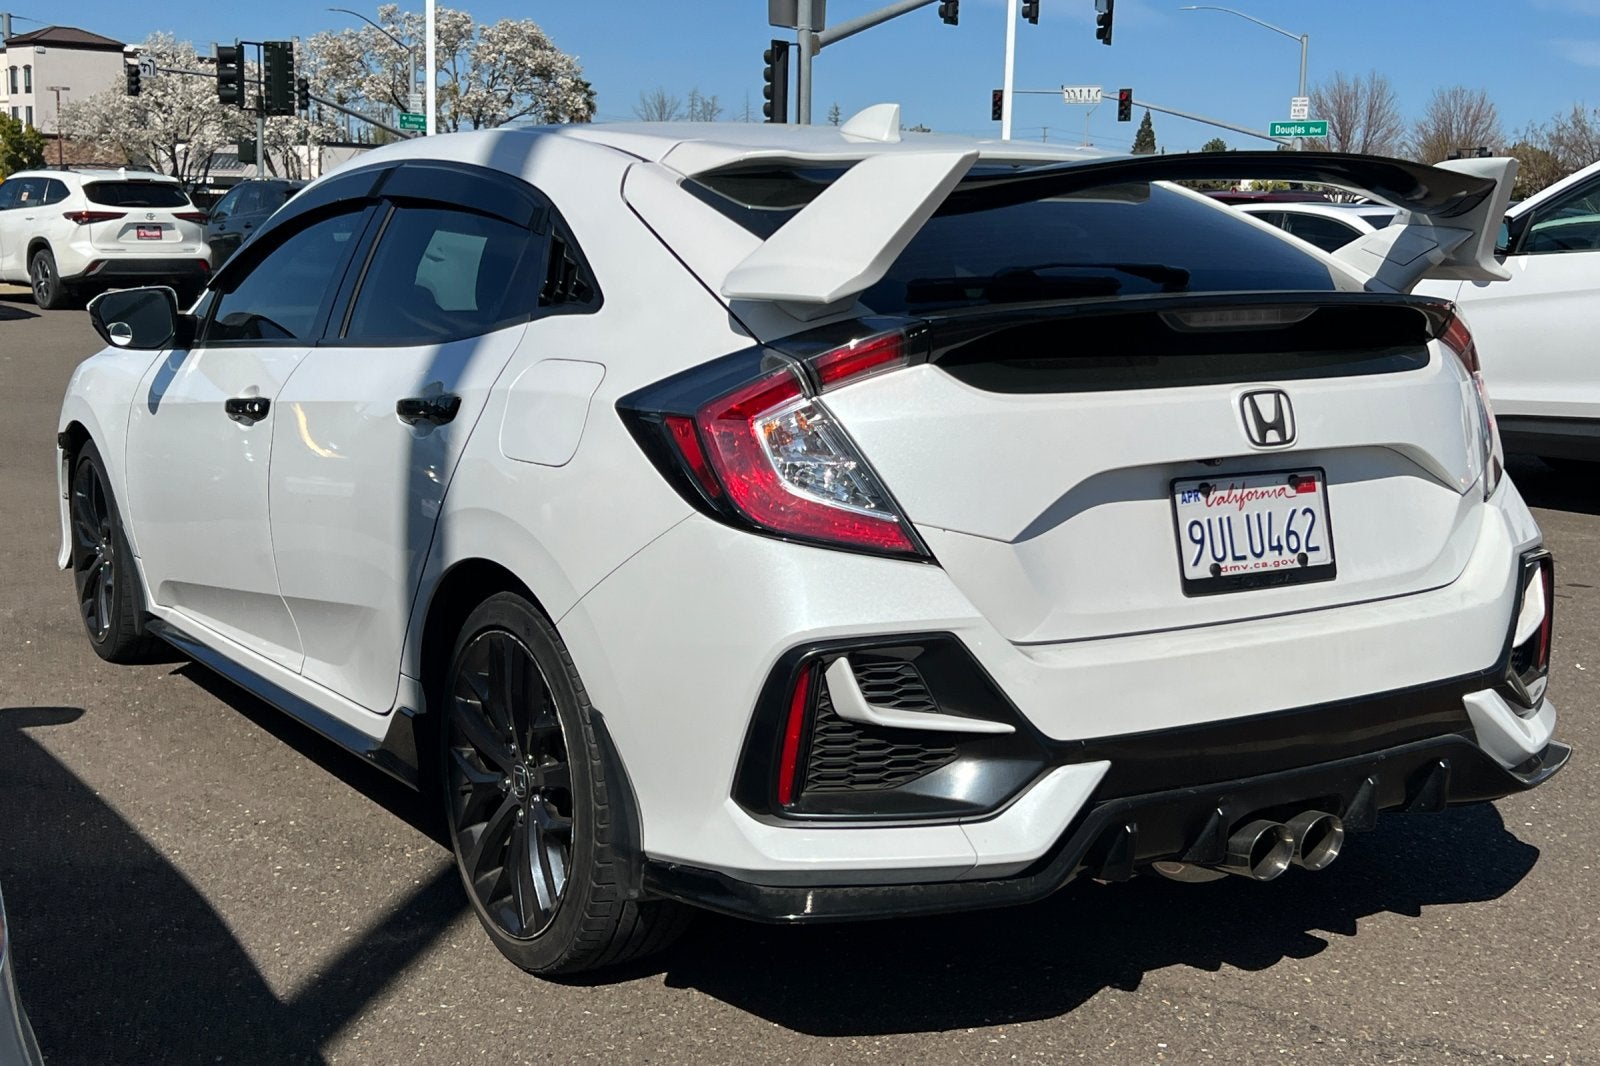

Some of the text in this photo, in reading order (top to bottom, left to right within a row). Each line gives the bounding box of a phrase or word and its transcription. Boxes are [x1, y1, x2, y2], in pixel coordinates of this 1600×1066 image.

[1275, 125, 1305, 136] Douglas
[1182, 490, 1200, 504] APR
[1205, 482, 1296, 511] California
[1189, 508, 1320, 566] 9ULU462
[1221, 558, 1295, 573] dmv.ca.gov
